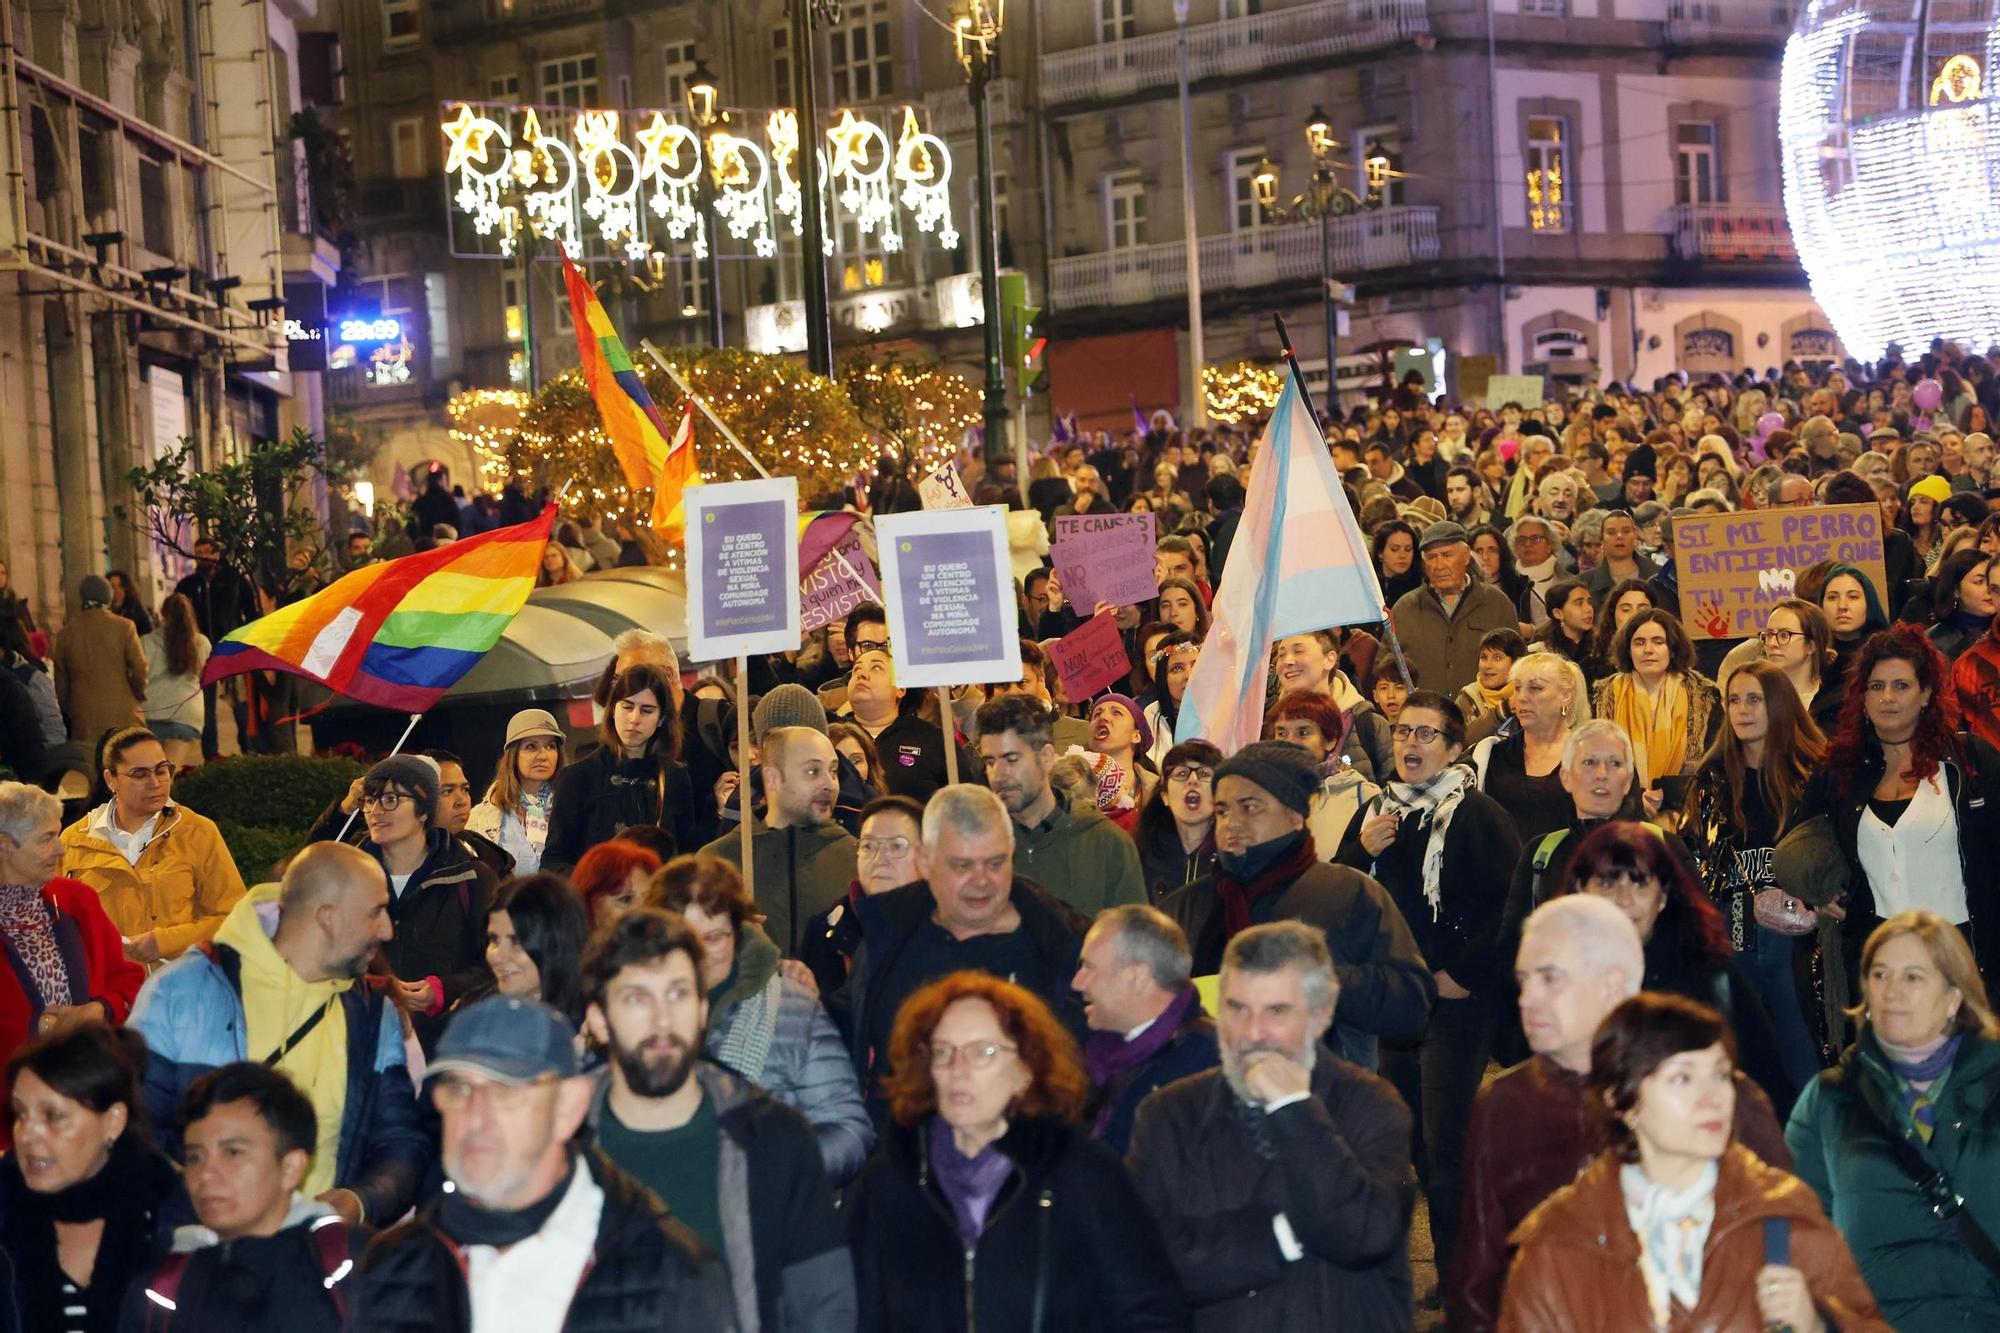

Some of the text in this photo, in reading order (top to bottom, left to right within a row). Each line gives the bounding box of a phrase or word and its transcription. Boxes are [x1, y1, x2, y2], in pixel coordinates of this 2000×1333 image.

[1058, 516, 1148, 533] TE CANSAS
[1679, 514, 1876, 549] SI MI PERRO
[735, 541, 765, 550] CENTRO
[719, 552, 729, 560] DE
[1690, 540, 1883, 574] ENTIENDE QUE
[718, 565, 769, 576] DE VIOLENCIA
[938, 563, 967, 572] QUERO
[729, 575, 758, 583] SEXUAL
[1758, 568, 1796, 594] NO
[719, 590, 768, 600] COMUNIDADE
[810, 585, 843, 607] quien
[933, 593, 979, 603] VIOLENCIA
[1686, 589, 1724, 606] TU
[933, 604, 966, 612] SEXUAL
[923, 618, 980, 629] COMUNIDADE
